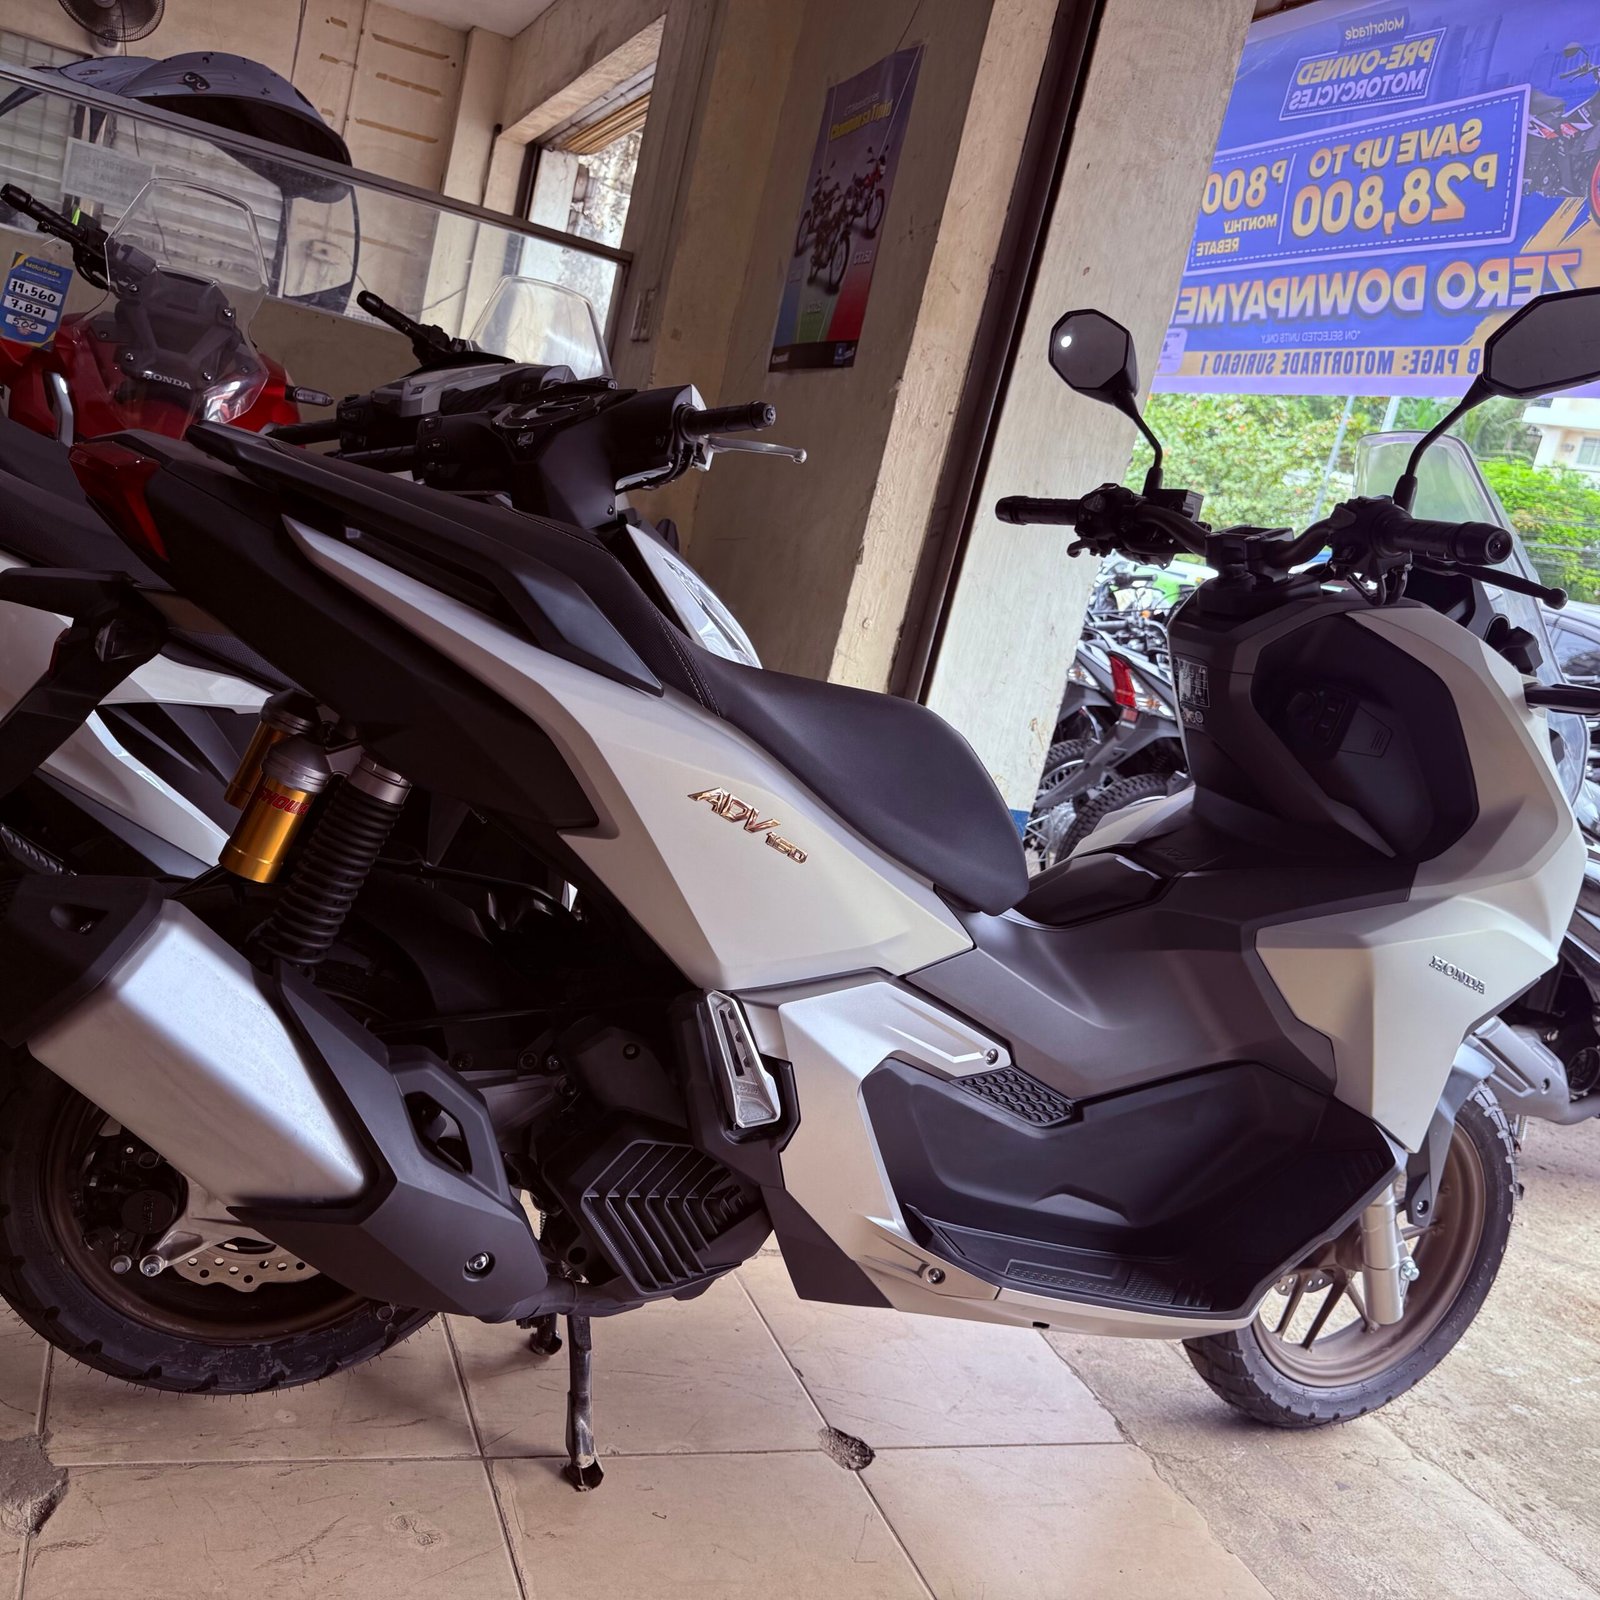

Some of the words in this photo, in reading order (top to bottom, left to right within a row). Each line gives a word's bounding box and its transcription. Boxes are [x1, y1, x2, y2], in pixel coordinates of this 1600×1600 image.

[142, 370, 192, 390] HONDA
[687, 786, 781, 834] ADV
[765, 831, 809, 865] 160
[1428, 955, 1486, 995] HONDA
